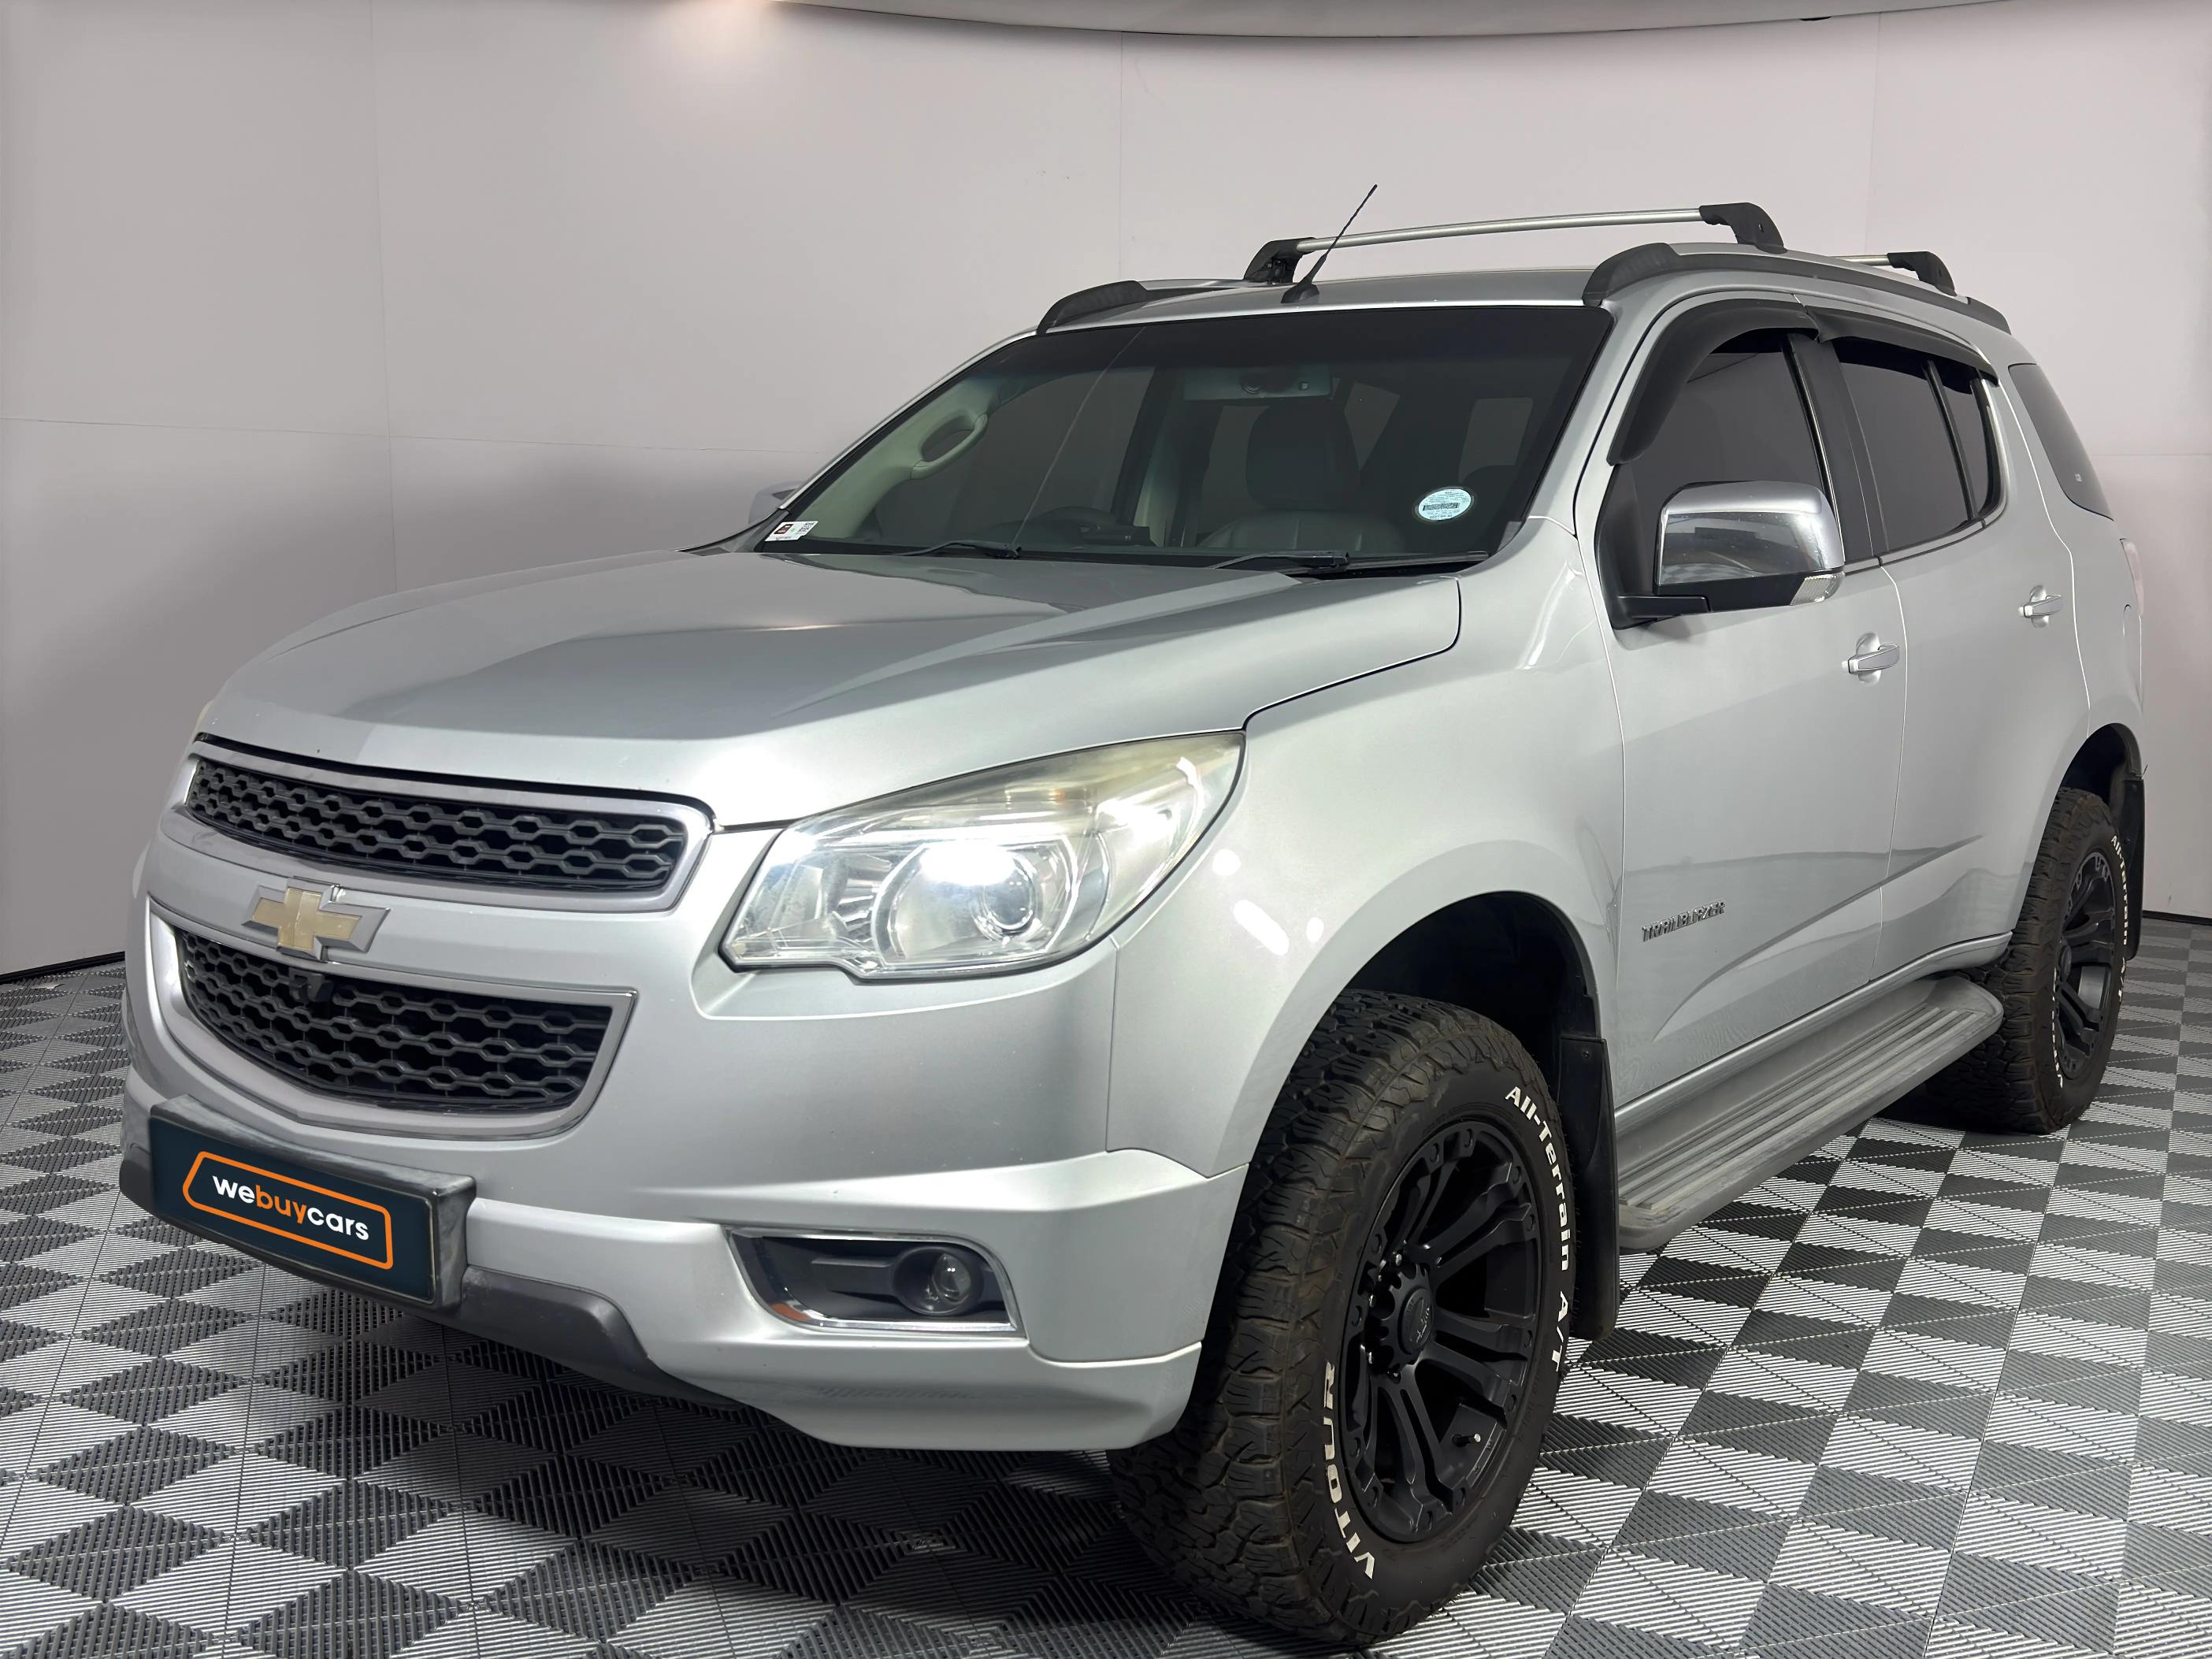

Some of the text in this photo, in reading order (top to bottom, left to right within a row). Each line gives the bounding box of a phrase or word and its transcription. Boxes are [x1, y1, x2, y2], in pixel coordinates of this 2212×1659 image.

[213, 1175, 369, 1241] webuycars
[1505, 1086, 1571, 1372] All-Terrain A/T
[1323, 1361, 1375, 1580] VITOUR
